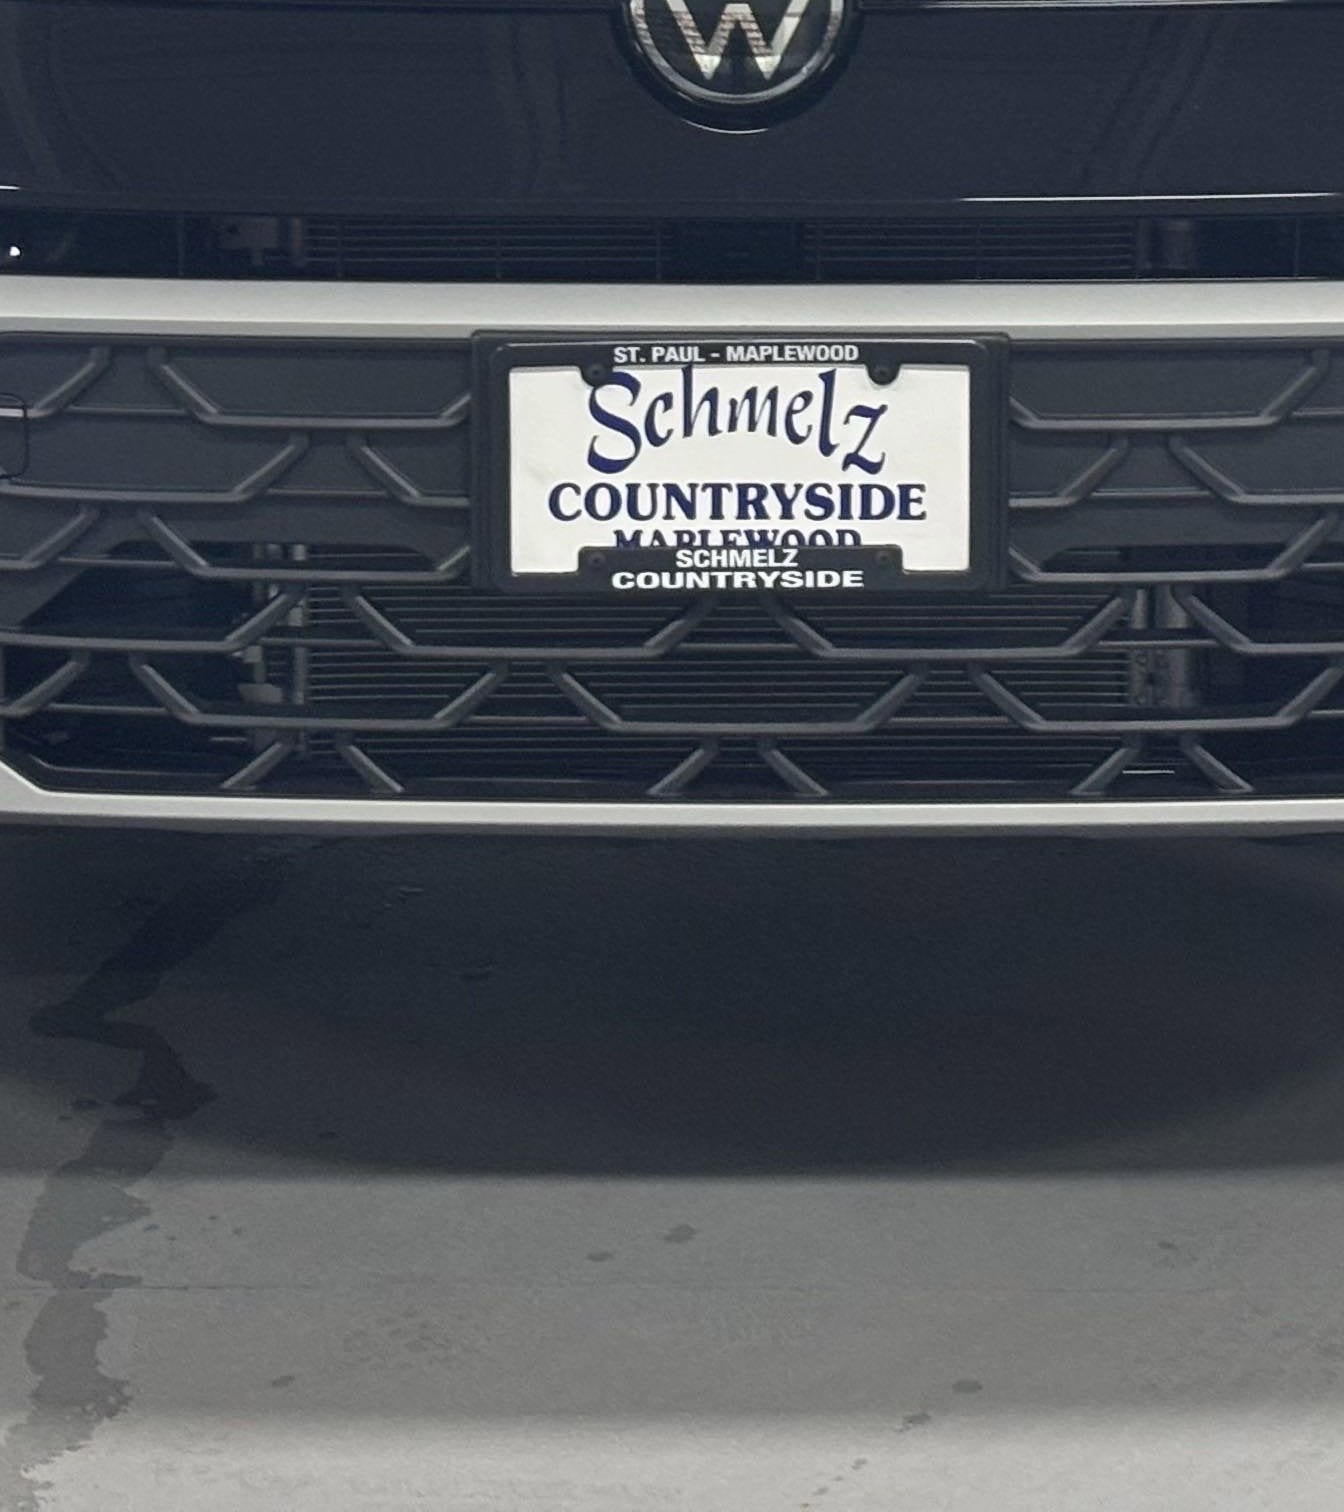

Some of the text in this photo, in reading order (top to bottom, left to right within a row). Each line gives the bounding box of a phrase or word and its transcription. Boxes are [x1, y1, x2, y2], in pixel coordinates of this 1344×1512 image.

[613, 345, 649, 364] ST.
[651, 345, 706, 364] PAUL
[726, 344, 860, 363] MAPLEWOOD
[587, 364, 888, 475] Schmelz
[548, 482, 927, 522] COUNTRYSIDE
[675, 548, 799, 568] SCHMELZ
[611, 569, 865, 589] COUNTRYSIDE
